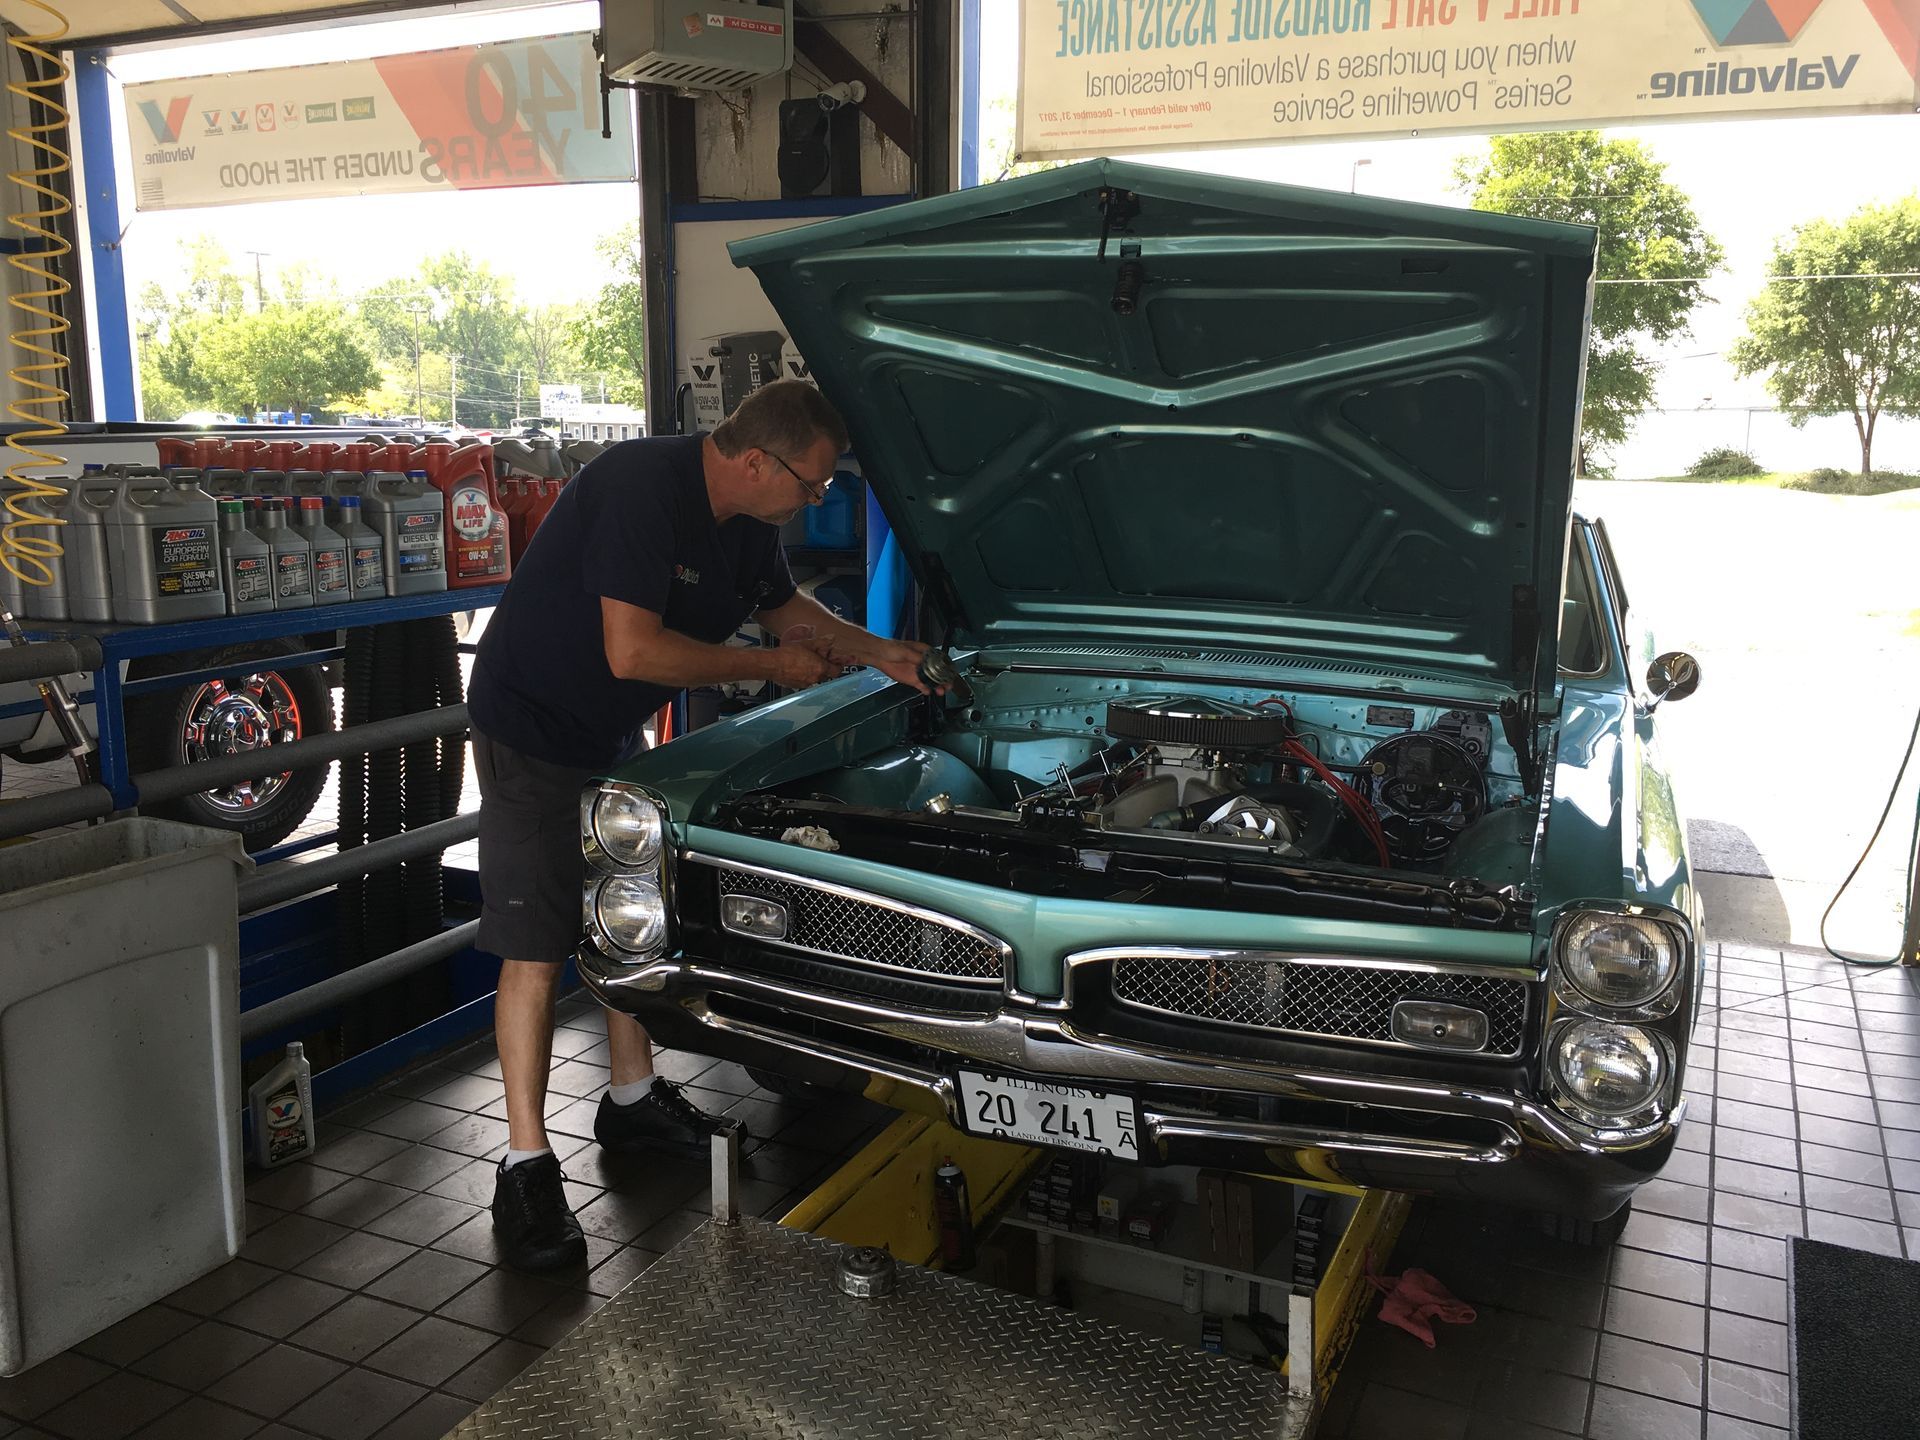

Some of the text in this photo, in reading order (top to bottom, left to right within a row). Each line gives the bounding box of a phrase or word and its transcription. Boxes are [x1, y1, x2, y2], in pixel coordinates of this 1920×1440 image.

[731, 20, 775, 32] MODINE
[748, 352, 762, 390] HETIC
[457, 504, 487, 520] MAX
[463, 519, 484, 529] LIFE
[162, 528, 206, 544] AMSOIL
[403, 532, 440, 544] DIESEL OIL
[164, 545, 210, 557] EUROPEAN
[180, 552, 210, 562] FORMULA
[469, 550, 489, 561] 0W-20
[183, 572, 195, 581] SAE
[184, 579, 202, 588] Motor
[202, 578, 210, 587] Oil
[1006, 1078, 1087, 1099] ILLINOIS
[976, 1090, 1102, 1143] 20 241
[1116, 1110, 1133, 1131] E
[1011, 1131, 1094, 1151] LAND OF LINCOLN
[1118, 1131, 1138, 1151] A
